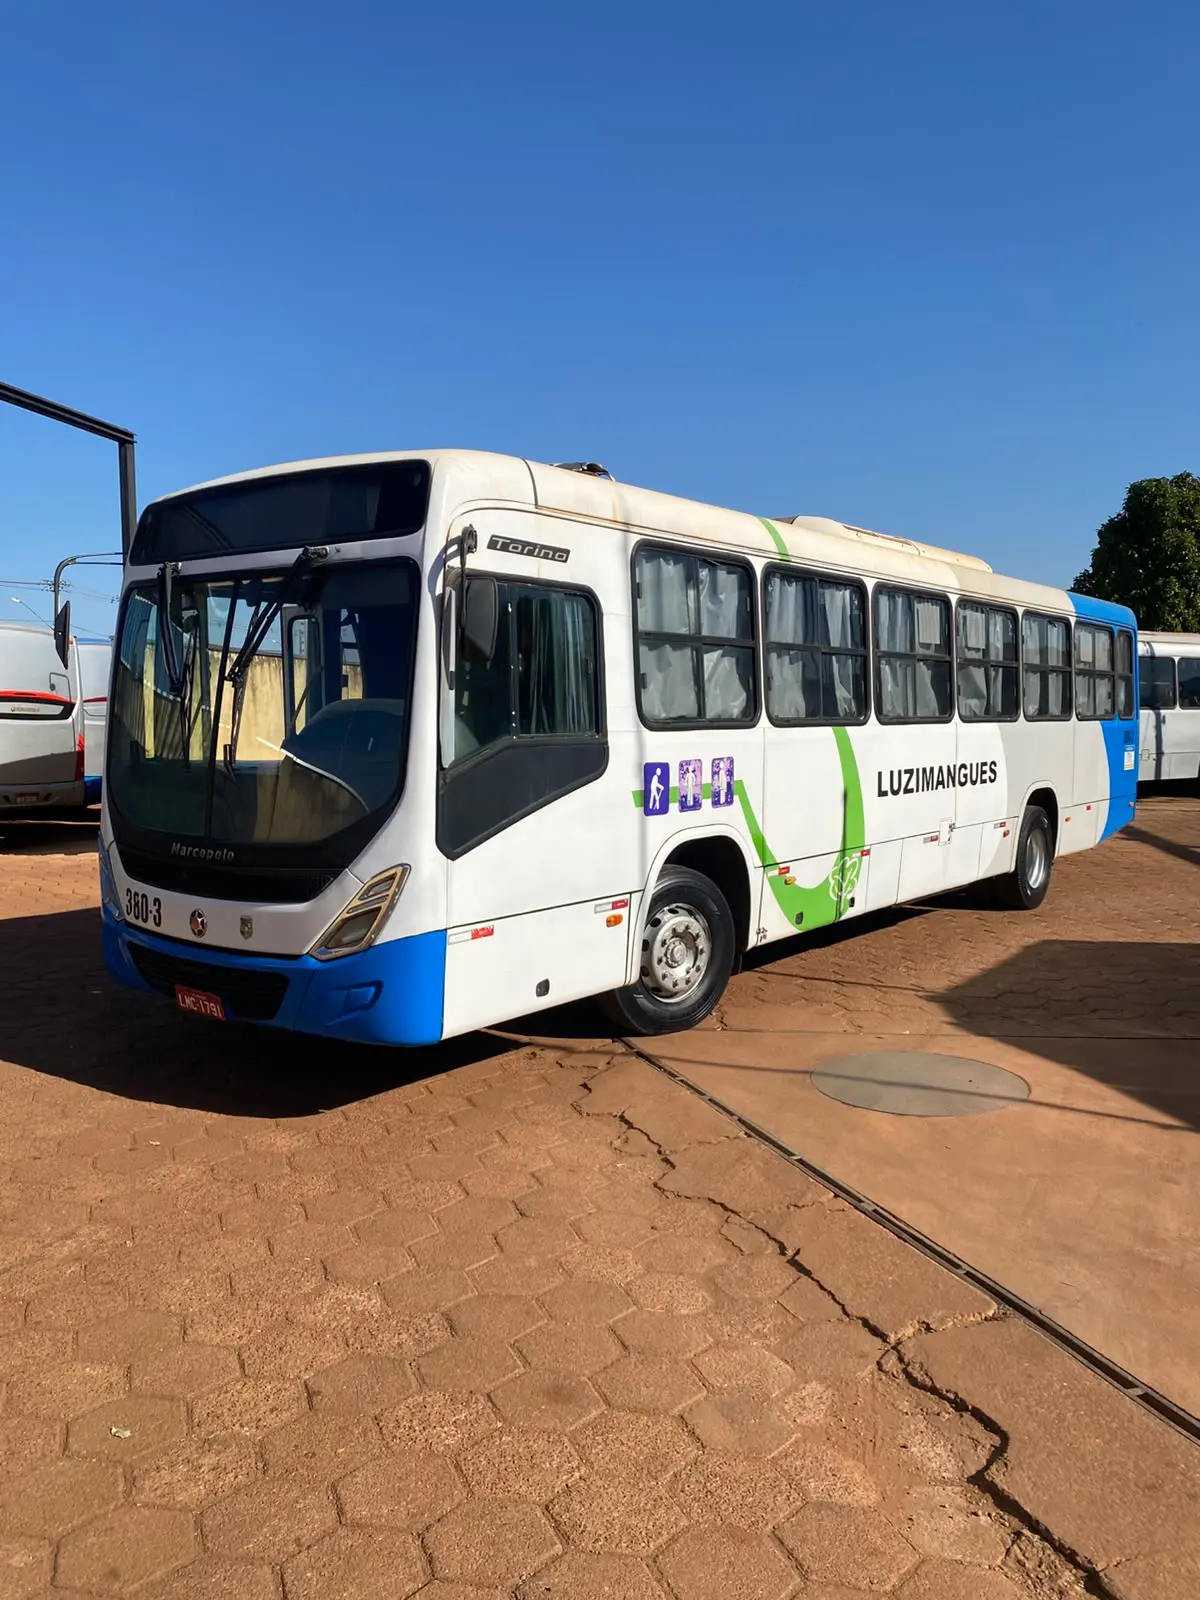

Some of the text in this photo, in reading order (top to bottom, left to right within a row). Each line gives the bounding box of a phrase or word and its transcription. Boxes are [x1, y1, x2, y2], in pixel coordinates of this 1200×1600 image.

[491, 536, 567, 561] Torino
[877, 760, 998, 798] LUZIMANGUES
[170, 842, 235, 860] Marcopolo
[125, 887, 162, 928] 380-3
